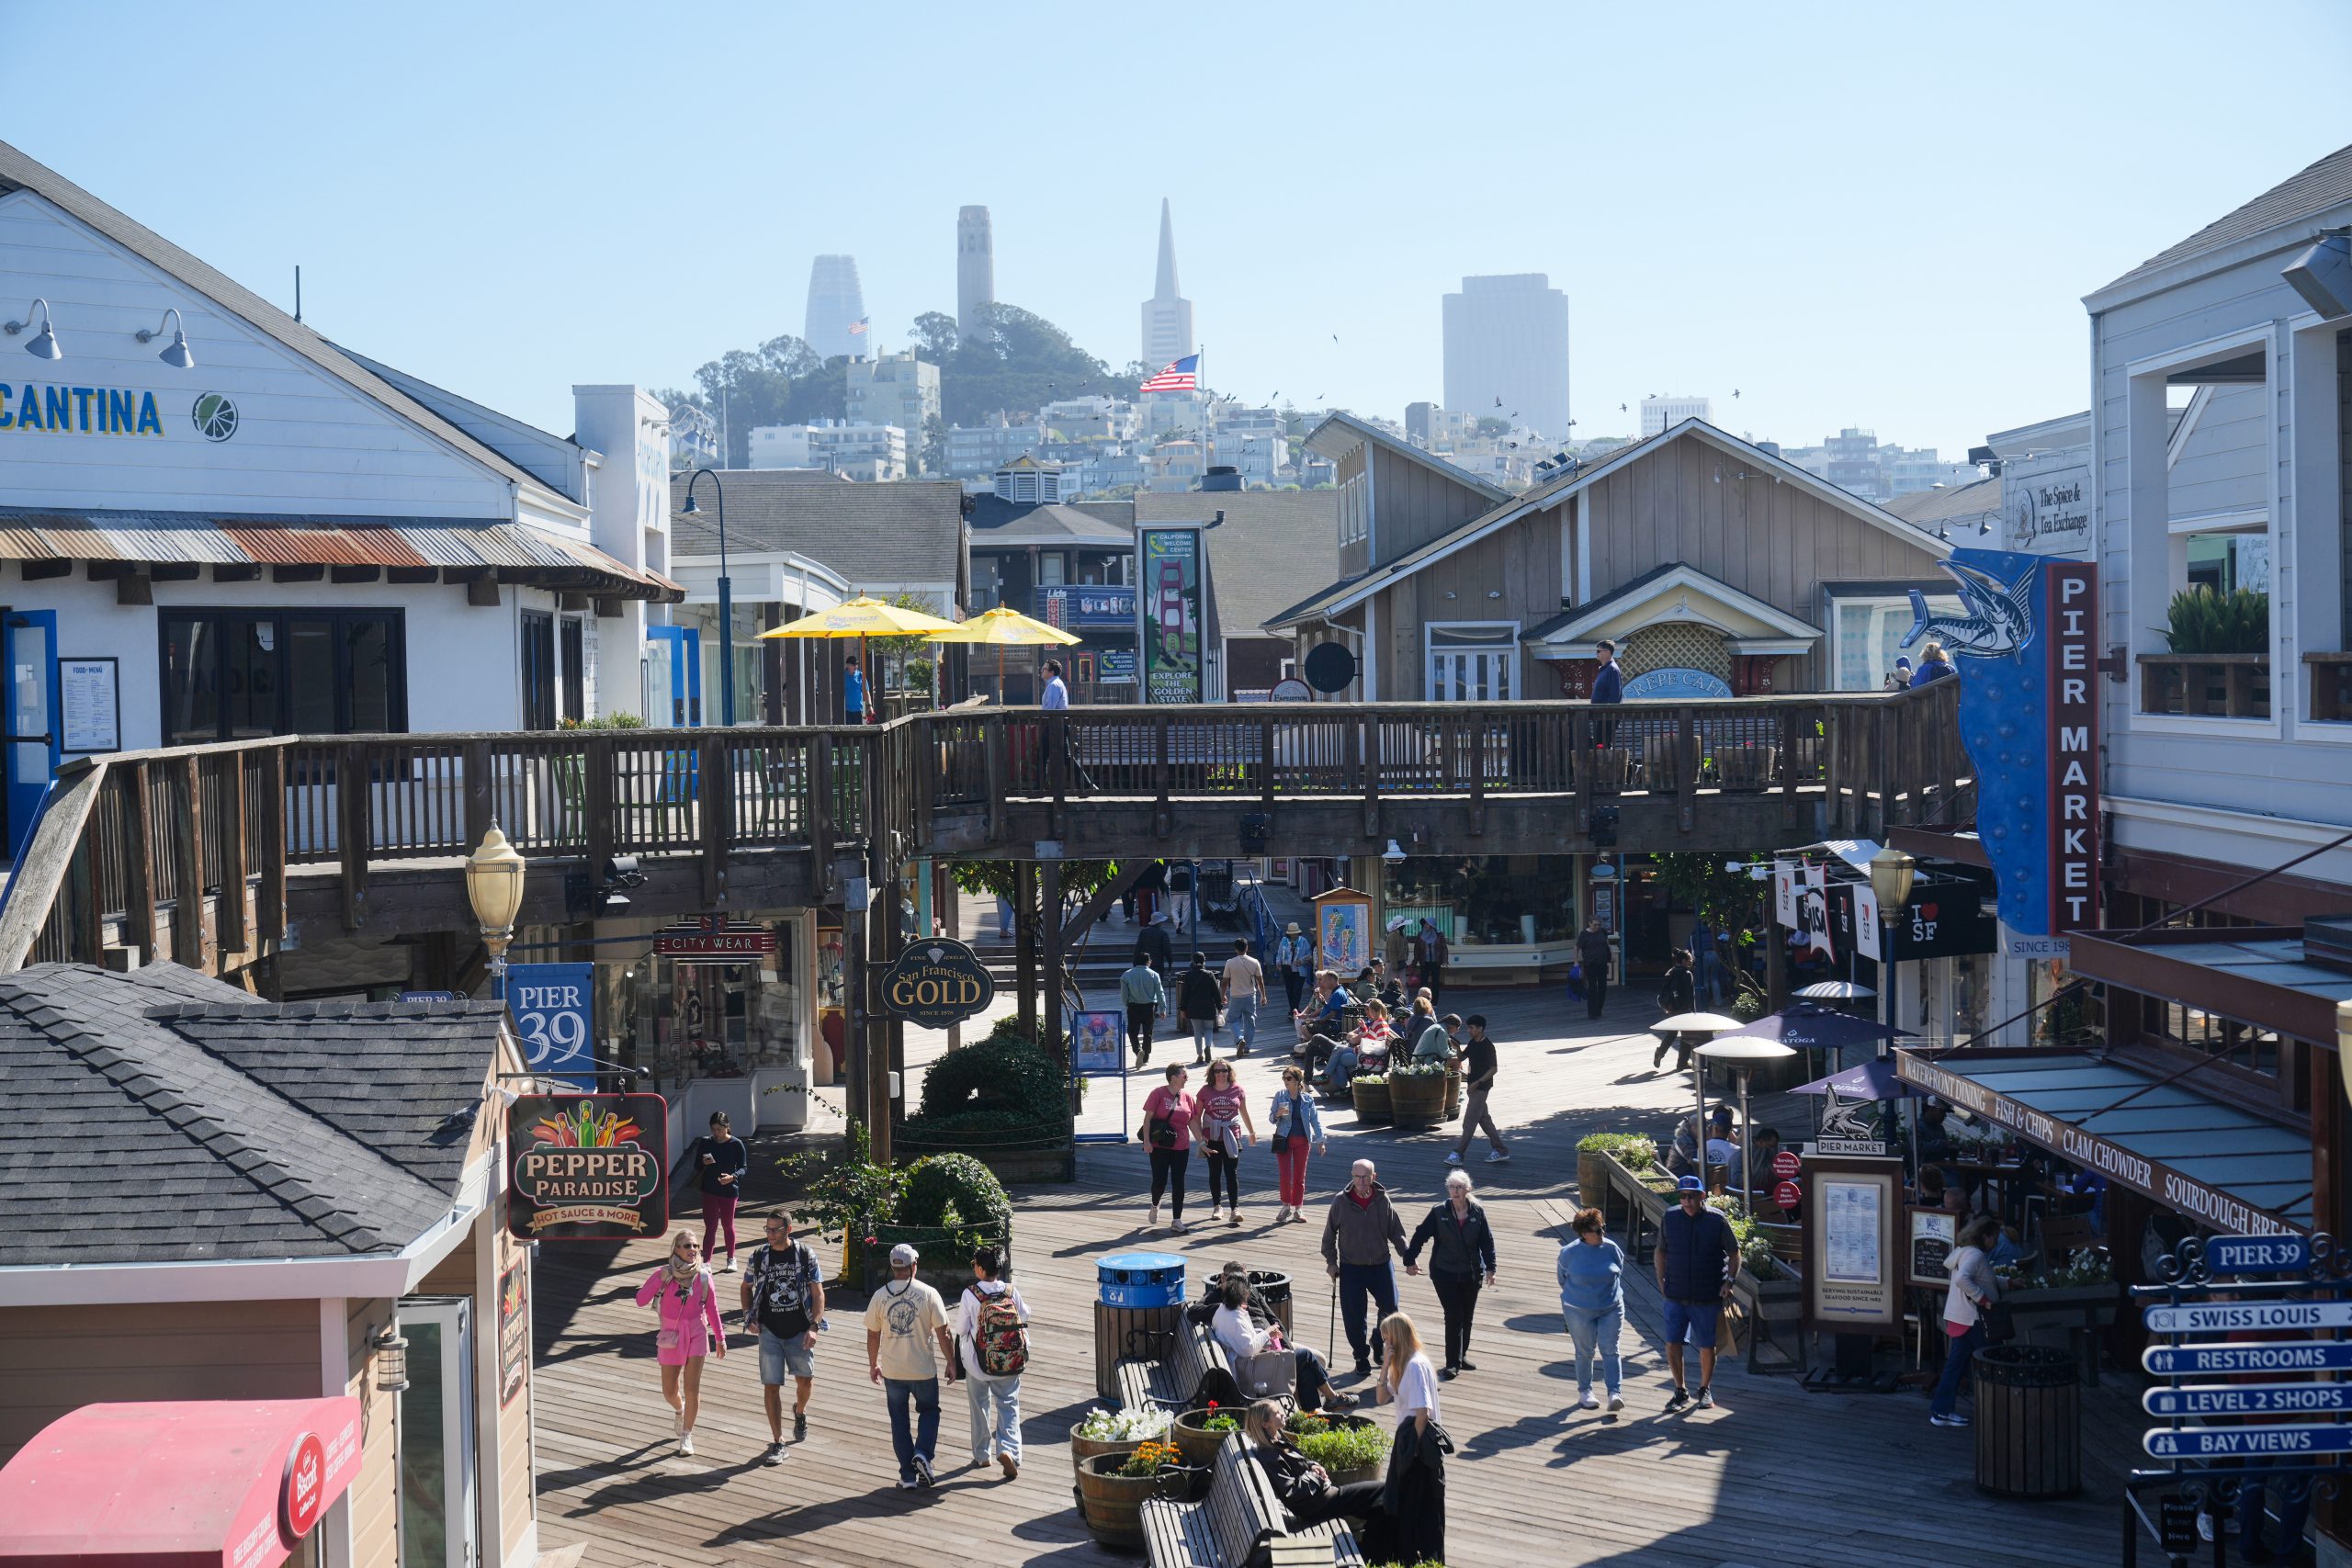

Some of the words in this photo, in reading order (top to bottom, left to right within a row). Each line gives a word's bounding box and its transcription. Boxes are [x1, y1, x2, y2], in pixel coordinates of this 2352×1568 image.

[0, 383, 164, 435] CANTINA
[2040, 487, 2052, 508] The
[2053, 485, 2073, 511] Spice
[2074, 482, 2080, 502] &
[2041, 515, 2052, 534] Tea
[2053, 511, 2087, 536] Exchange
[1047, 589, 1067, 598] Lids
[2062, 578, 2086, 705] PIER
[1152, 671, 1193, 680] EXPLORE
[2061, 726, 2088, 921] MARKET
[1808, 906, 1827, 938] USA
[1911, 904, 1922, 923] I
[1912, 922, 1937, 942] SF
[672, 938, 707, 949] CITY
[712, 938, 752, 949] WEAR
[2014, 942, 2049, 953] SINCE
[2053, 942, 2071, 952] 198
[899, 971, 919, 983] San
[922, 964, 974, 983] Francisco
[518, 986, 582, 1009] PIER
[892, 980, 981, 1006] GOLD
[519, 1010, 585, 1065] 39
[1821, 1143, 1841, 1151] PIER
[1844, 1144, 1883, 1153] MARKET
[1905, 1057, 1954, 1097] WATERFRONT
[1955, 1079, 1986, 1112] DINING
[1995, 1097, 2016, 1126] FISH
[2016, 1107, 2024, 1129] &
[2025, 1111, 2053, 1145] CHIPS
[2063, 1129, 2093, 1167] CLAM
[2094, 1142, 2153, 1190] CHOWDER
[2165, 1172, 2250, 1235] SOURDOUGH
[526, 1154, 647, 1178] PEPPER
[536, 1179, 639, 1196] PARADISE
[537, 1211, 560, 1224] HOT
[560, 1208, 595, 1218] SAUCE
[597, 1208, 604, 1217] &
[606, 1210, 639, 1224] MORE
[2220, 1245, 2274, 1267] PIER
[2276, 1243, 2301, 1264] 39
[2189, 1309, 2254, 1327] SWISS
[2259, 1307, 2322, 1325] LOUIS
[503, 1311, 523, 1350] PEPPER
[2197, 1348, 2326, 1369] RESTROOMS
[2186, 1393, 2250, 1412] LEVEL
[2255, 1392, 2267, 1409] 2
[2273, 1389, 2344, 1408] SHOPS
[2199, 1434, 2241, 1452] BAY
[2245, 1431, 2312, 1450] VIEWS
[297, 1454, 317, 1503] Biscoff
[309, 1491, 317, 1507] Cart
[2164, 1503, 2194, 1511] Please
[2168, 1532, 2190, 1540] Here
